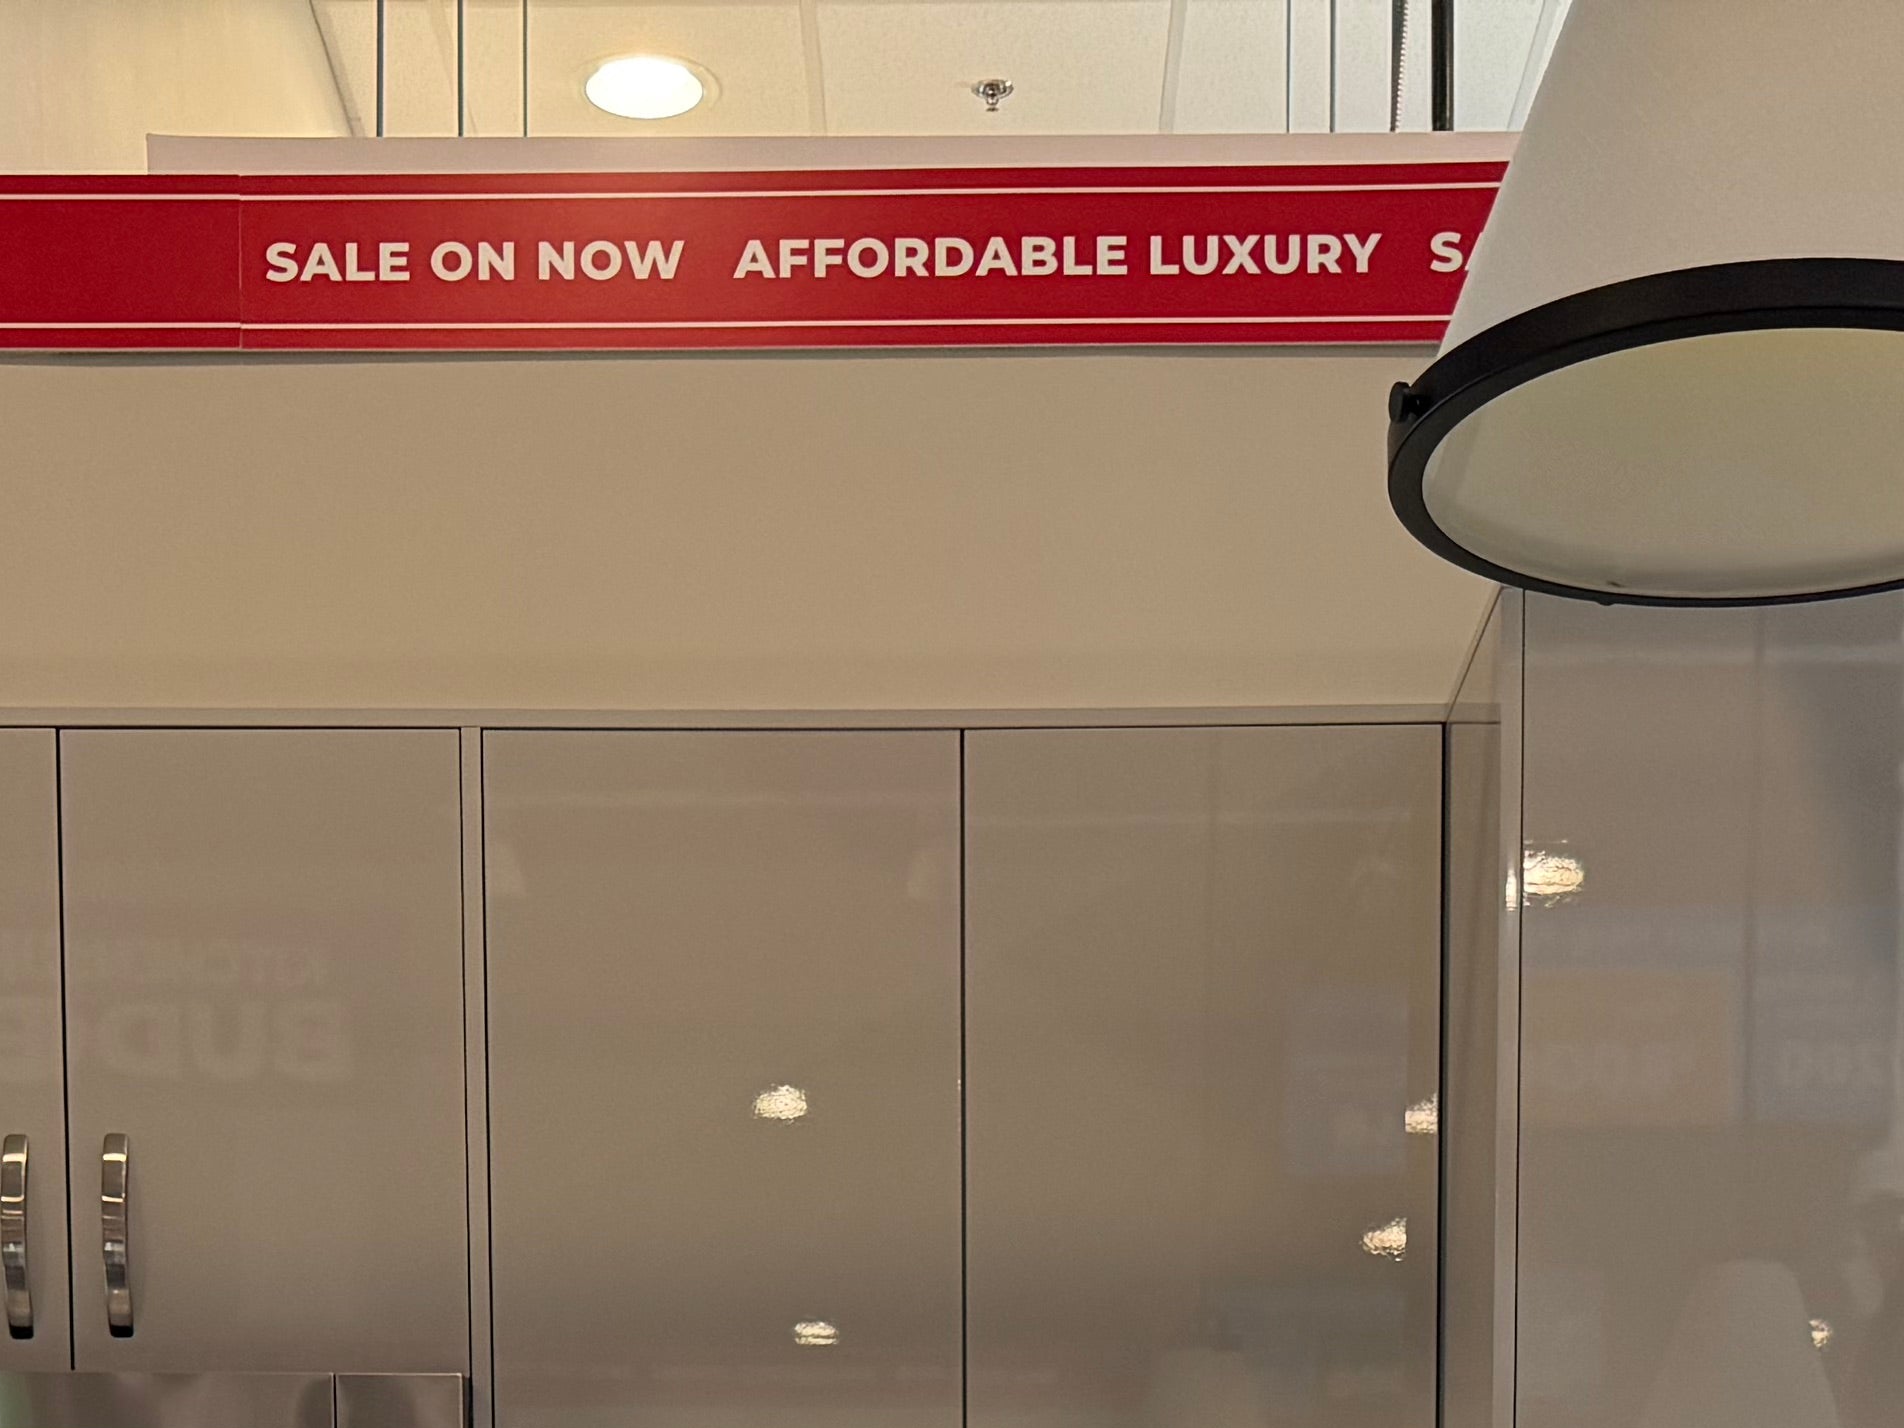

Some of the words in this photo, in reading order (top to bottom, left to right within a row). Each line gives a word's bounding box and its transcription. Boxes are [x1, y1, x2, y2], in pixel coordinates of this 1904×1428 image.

[266, 242, 411, 283] SALE
[430, 241, 516, 282] ON
[538, 240, 686, 281] NOW
[733, 235, 1129, 279] AFFORDABLE
[1150, 233, 1382, 275] LUXURY
